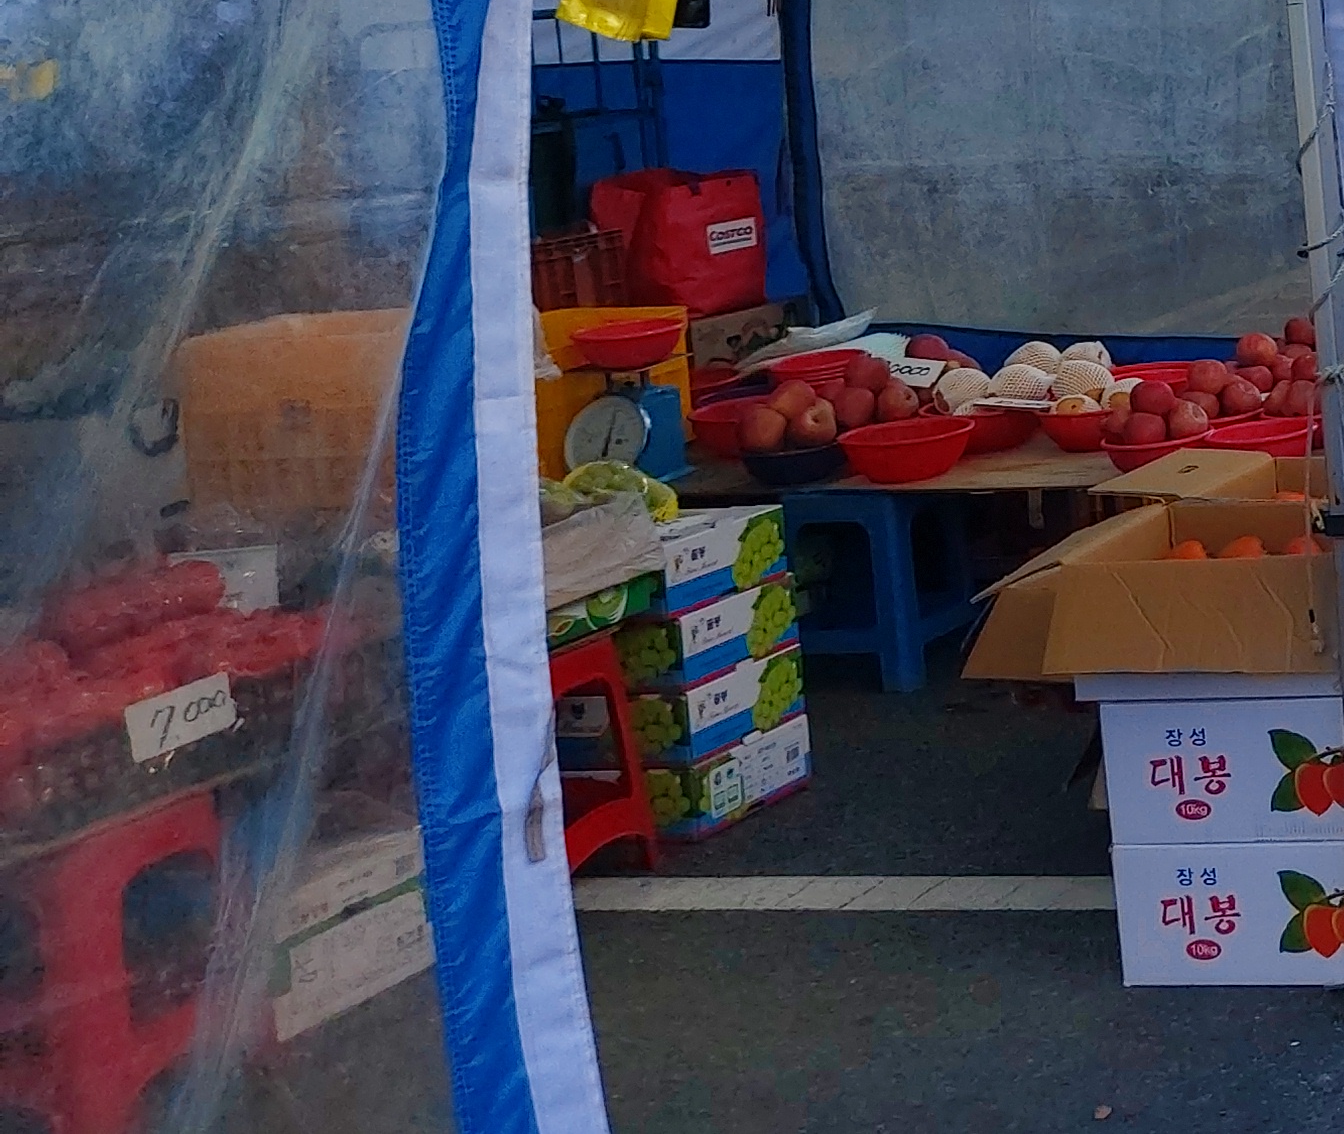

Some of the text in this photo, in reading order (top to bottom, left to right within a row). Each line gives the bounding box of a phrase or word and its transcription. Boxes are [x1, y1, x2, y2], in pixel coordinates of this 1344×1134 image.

[709, 226, 753, 241] COSTCO
[1179, 803, 1208, 817] 10kg
[1189, 943, 1219, 957] 10kg
